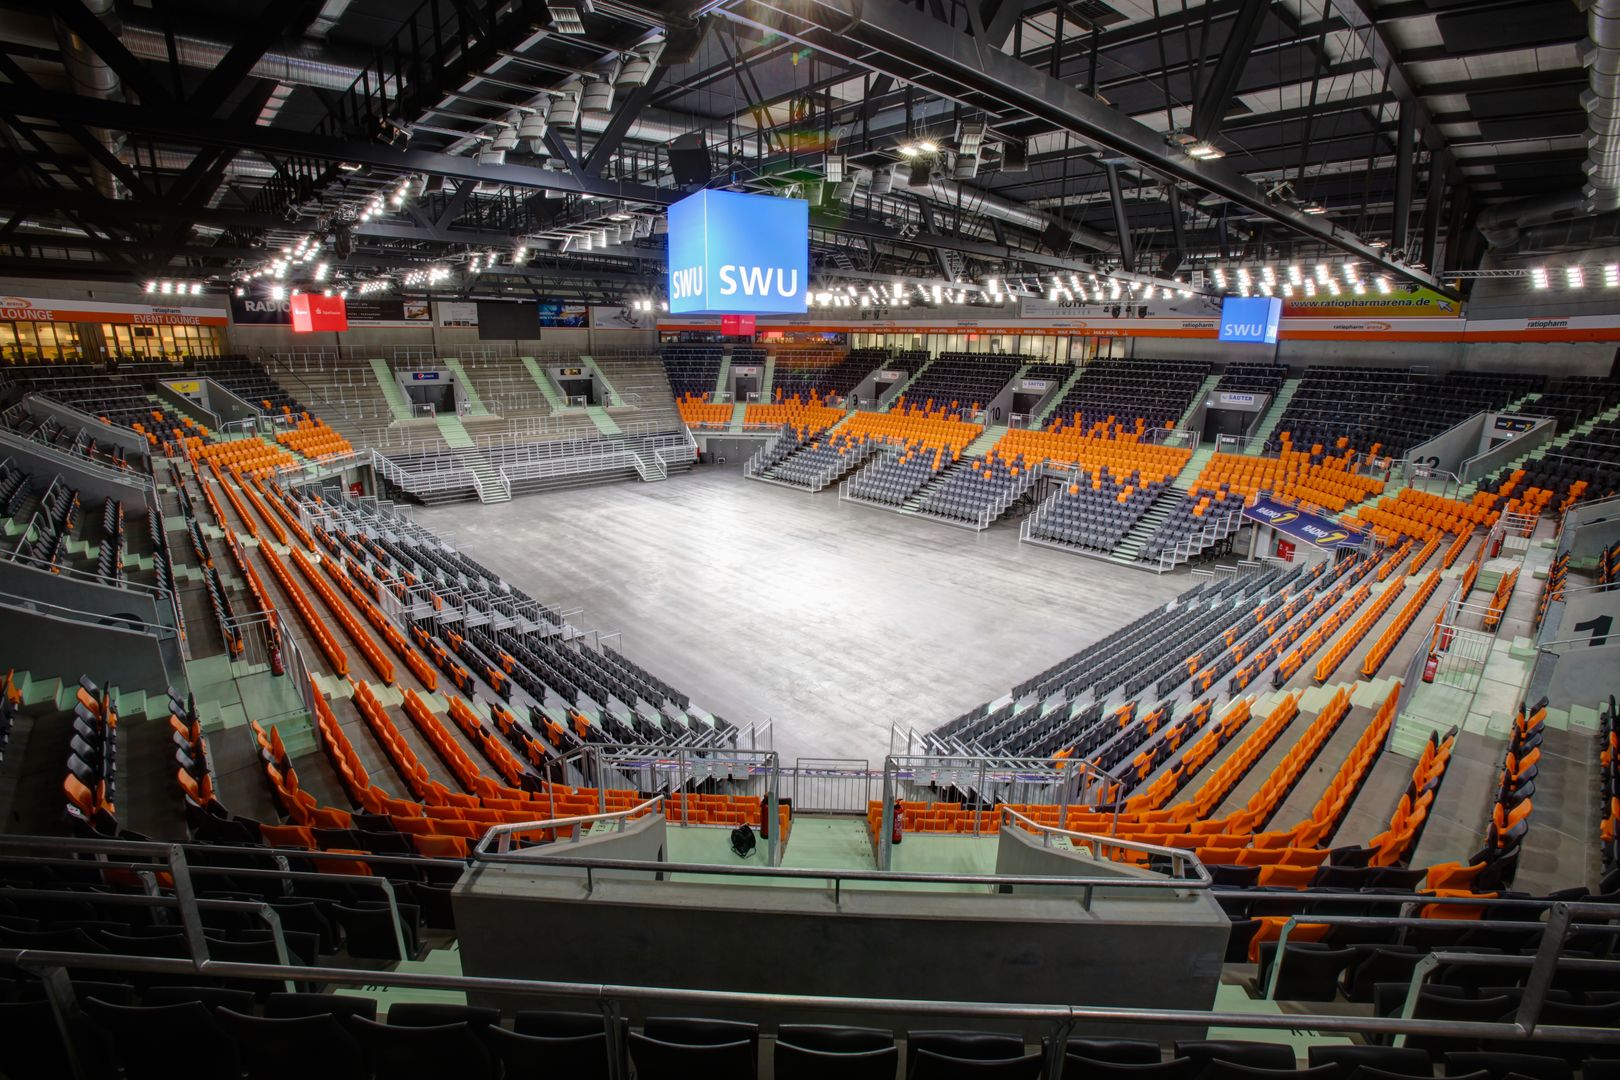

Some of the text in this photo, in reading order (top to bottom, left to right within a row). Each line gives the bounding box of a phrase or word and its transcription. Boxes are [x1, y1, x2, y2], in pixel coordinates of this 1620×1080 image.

[673, 265, 703, 299] SWU
[719, 264, 797, 297] SWU
[244, 300, 291, 312] RADIO
[1291, 298, 1430, 308] www.ratiopharmarena.de
[0, 308, 54, 320] LOUNGE
[134, 314, 200, 325] EVENT LOUNGE
[1224, 324, 1262, 336] SWU
[1528, 320, 1567, 328] ratiopharm
[1229, 394, 1253, 402] SAUTER
[991, 407, 1001, 421] 10
[1256, 507, 1281, 519] RADIO
[1302, 525, 1329, 538] RADIO
[1574, 615, 1613, 647] 1
